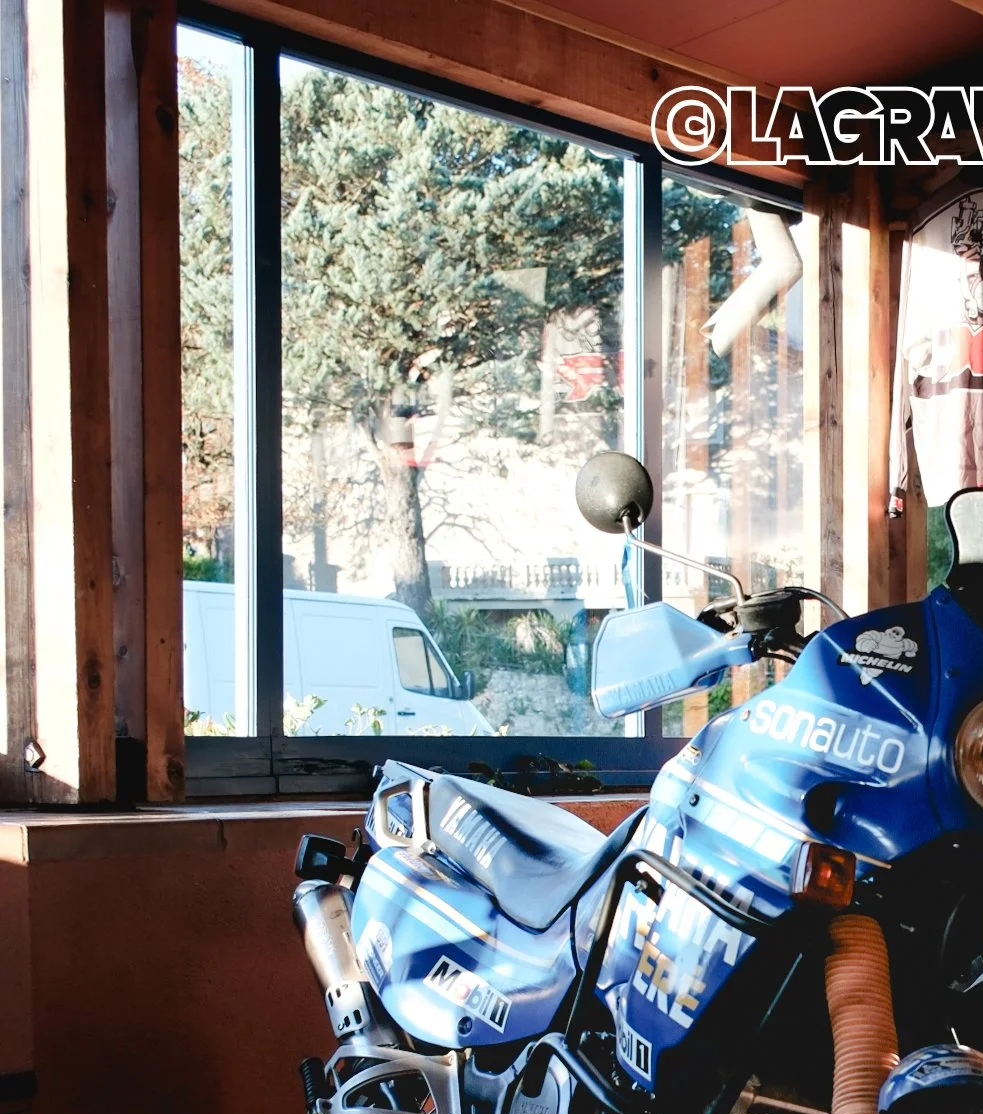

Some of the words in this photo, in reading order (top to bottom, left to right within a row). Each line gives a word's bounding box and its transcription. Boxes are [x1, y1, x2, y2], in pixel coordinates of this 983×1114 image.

[840, 652, 913, 674] MICHELIN
[749, 699, 906, 775] sonauto
[439, 795, 508, 870] YAMAHA
[430, 960, 493, 1018] Mobil
